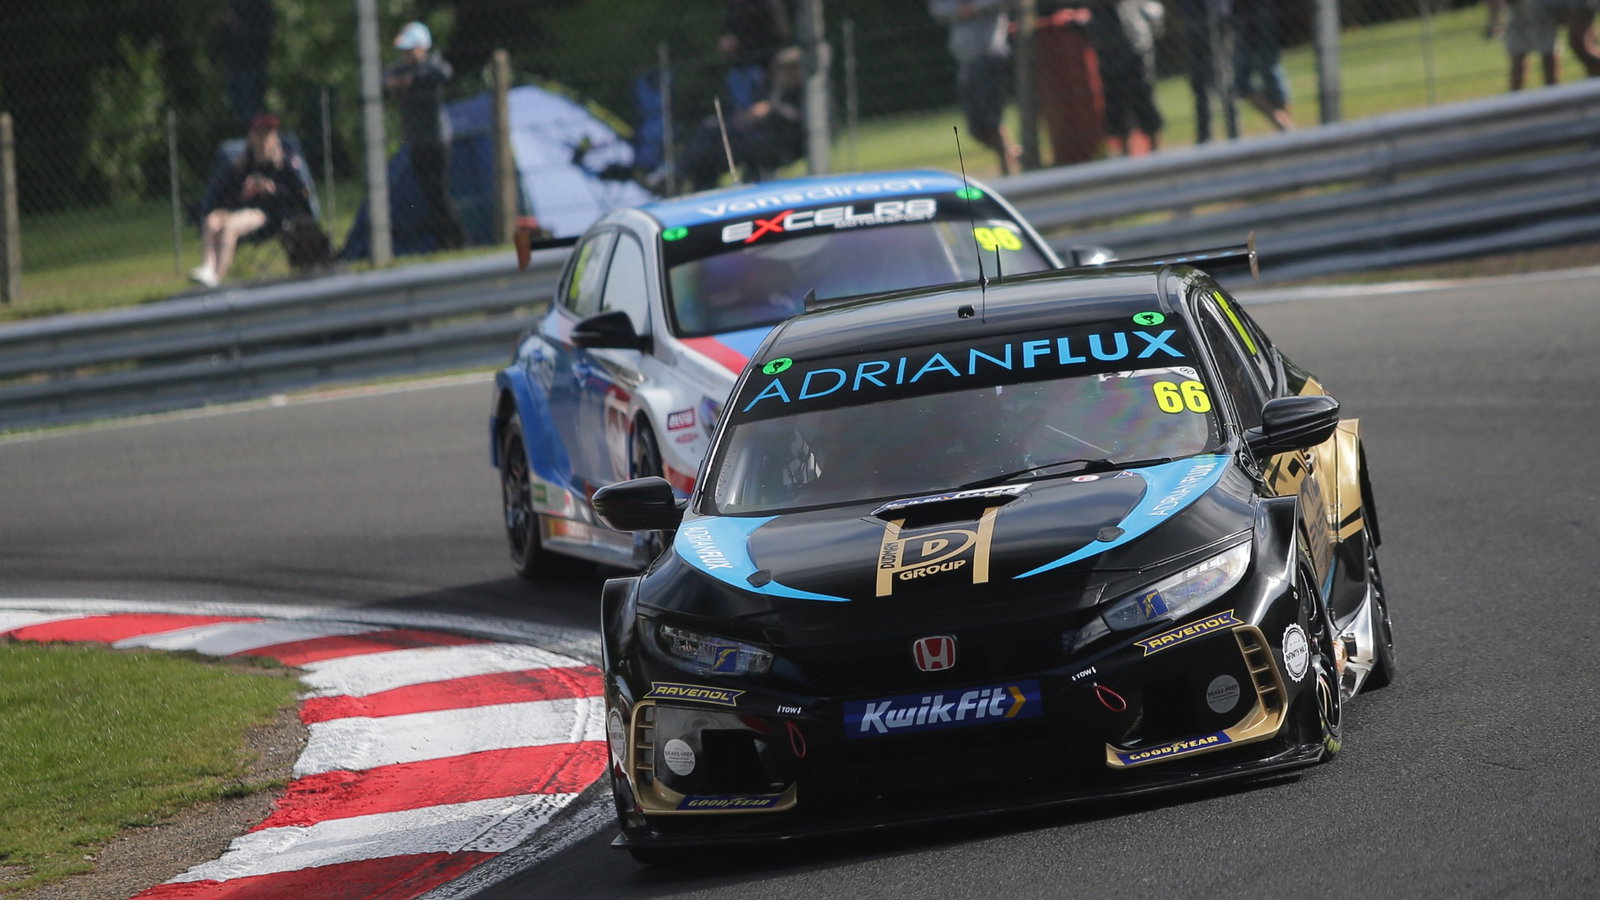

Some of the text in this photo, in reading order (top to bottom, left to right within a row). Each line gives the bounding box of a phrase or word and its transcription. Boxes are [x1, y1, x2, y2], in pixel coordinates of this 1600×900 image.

[972, 226, 1022, 252] 96
[1152, 381, 1211, 414] 66
[880, 541, 899, 570] DUDMAN
[899, 559, 967, 581] GROUP
[1148, 617, 1231, 649] RAVENOL
[1076, 667, 1093, 680] TOW
[655, 686, 730, 701] RAVENOL
[1128, 735, 1219, 761] GOODYEAR
[687, 797, 771, 809] GOODYEAR
